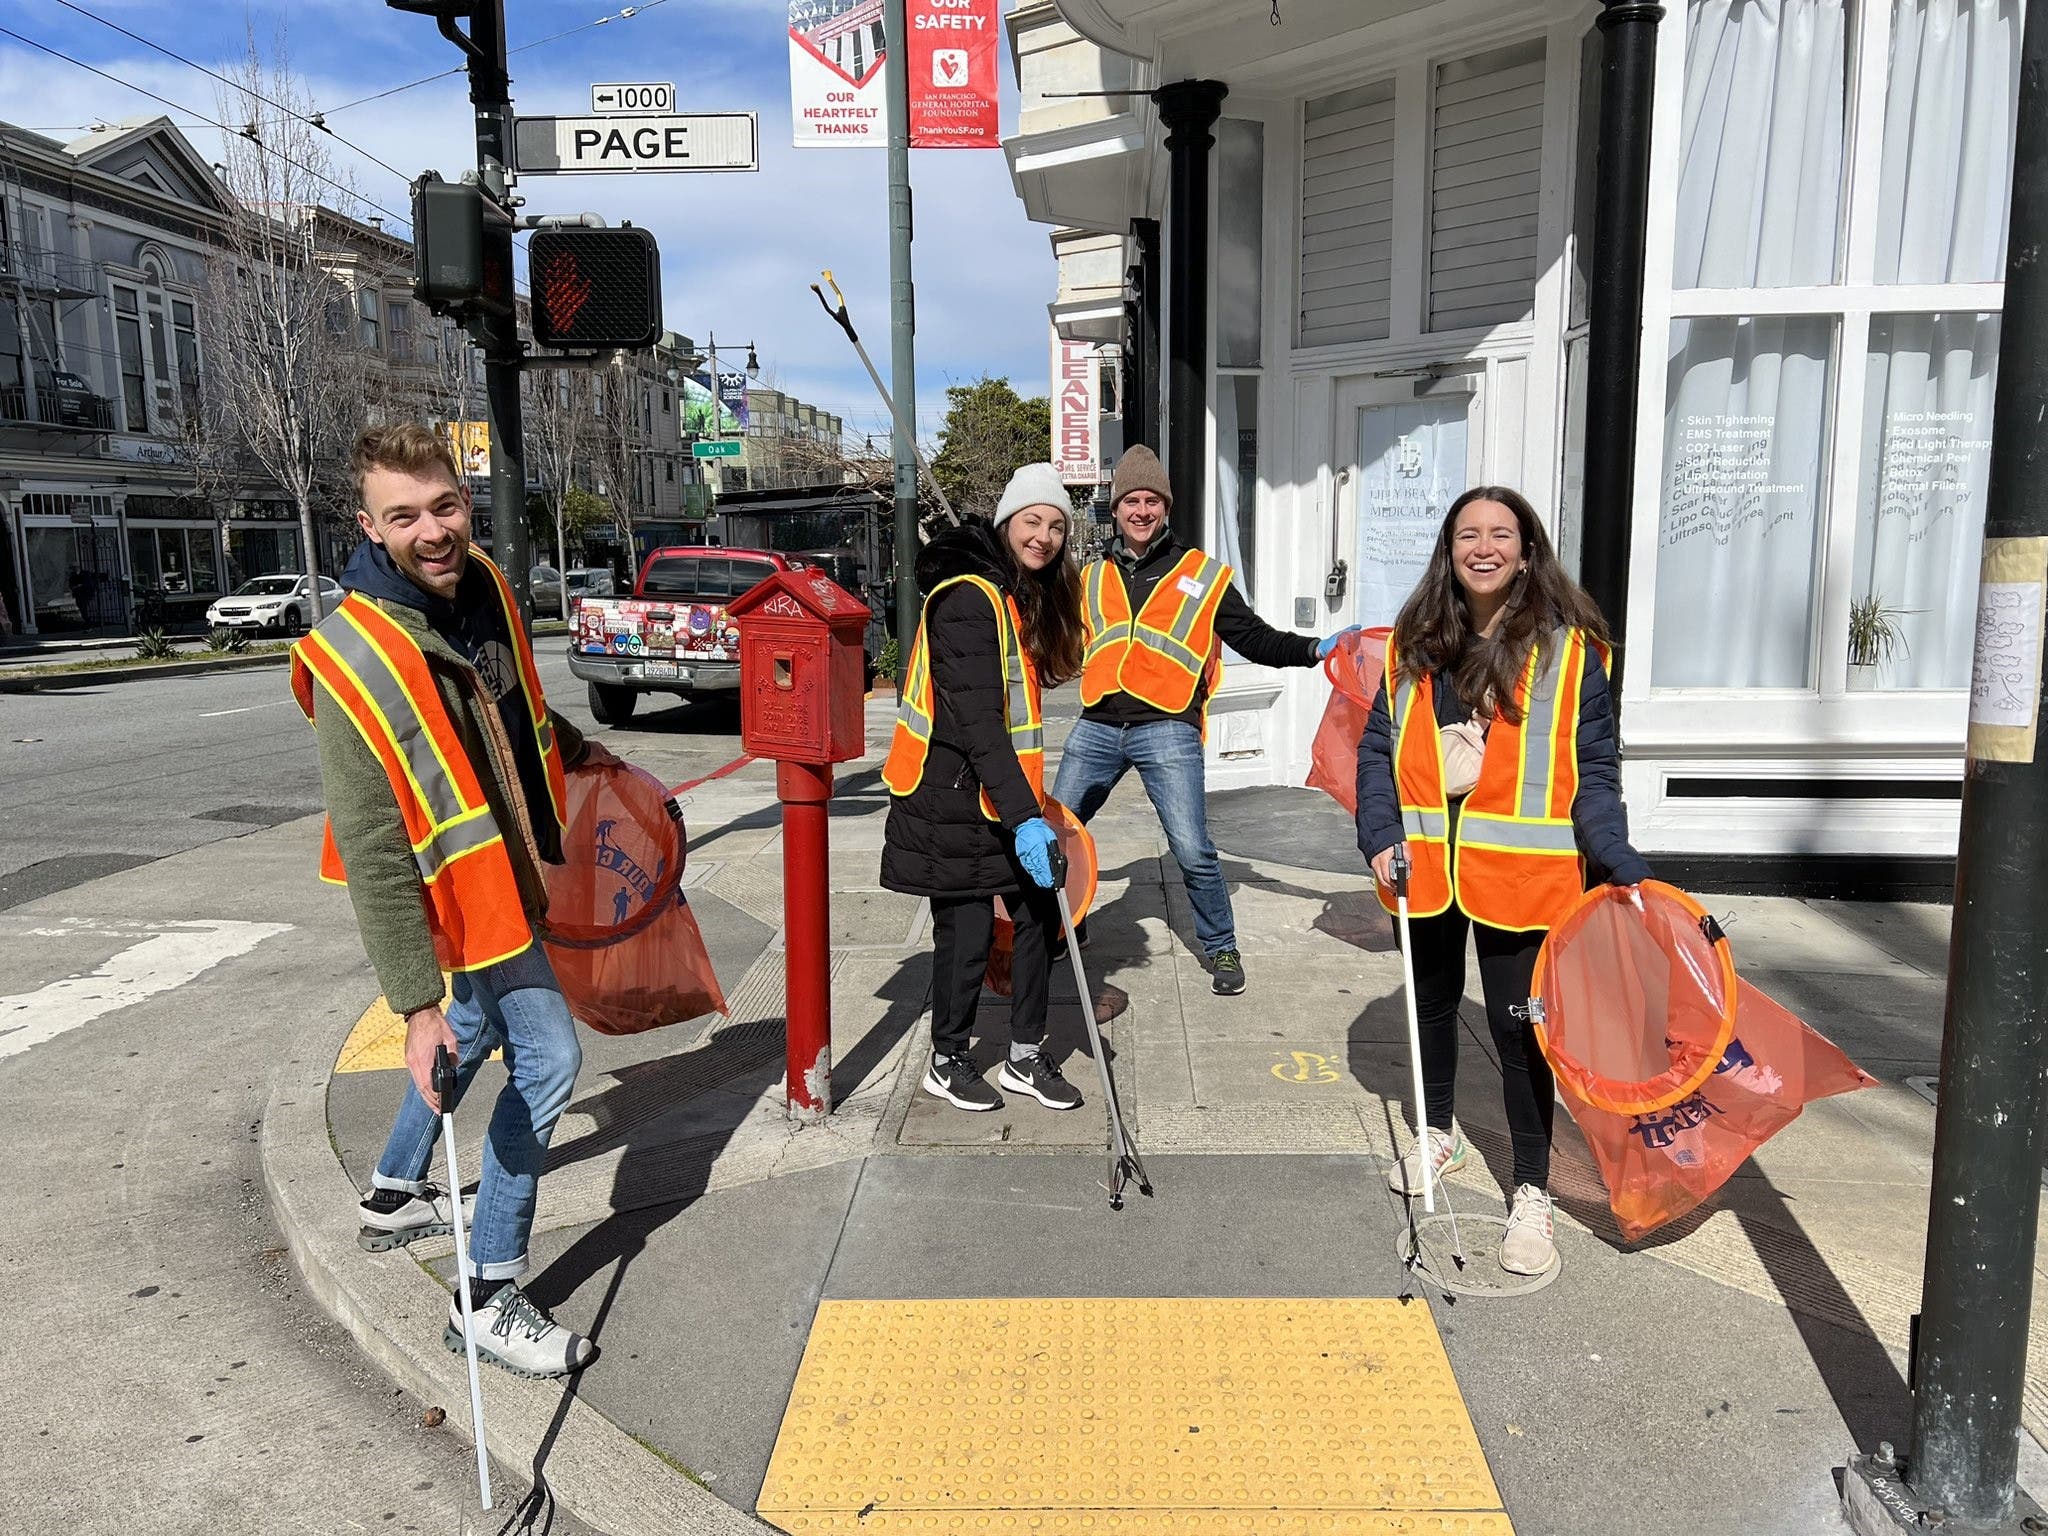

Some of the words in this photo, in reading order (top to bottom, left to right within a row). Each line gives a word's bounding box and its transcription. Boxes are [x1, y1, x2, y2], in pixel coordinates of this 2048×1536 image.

[915, 15, 986, 30] SAFETY
[617, 87, 667, 108] 1000
[826, 92, 855, 102] OUR
[912, 101, 948, 109] GENERAL
[950, 101, 990, 109] HOSPITAL
[804, 107, 878, 118] HEARTFELT
[923, 109, 978, 117] FOUNDATION
[815, 124, 869, 134] THANKS
[918, 126, 984, 136] ThankYouSF.org
[574, 127, 690, 160] PAGE
[1687, 415, 1712, 425] Skin
[1715, 414, 1775, 427] Tightening
[1894, 412, 1923, 421] Micro
[1926, 411, 1973, 423] Needling
[1686, 429, 1712, 439] EMS
[1715, 429, 1771, 438] Treatment
[1893, 426, 1945, 436] Exosome
[708, 446, 725, 454] Oak
[1686, 443, 1709, 453] CO2
[1712, 443, 1744, 452] Laser
[1891, 440, 1917, 449] Red
[1918, 440, 1947, 451] Light
[1685, 457, 1711, 466] Scar
[1714, 456, 1770, 466] Reduction
[1891, 453, 1943, 463] Chemical
[1947, 453, 1971, 462] Peel
[1684, 472, 1709, 483] Lipo
[1712, 471, 1768, 480] Cavitation
[1889, 468, 1924, 477] Botox
[1683, 484, 1747, 494] Ultrasound
[1749, 484, 1804, 493] Treatment
[1889, 481, 1929, 491] Dermal
[1932, 481, 1967, 491] Fillers
[763, 595, 805, 618] KIRA
